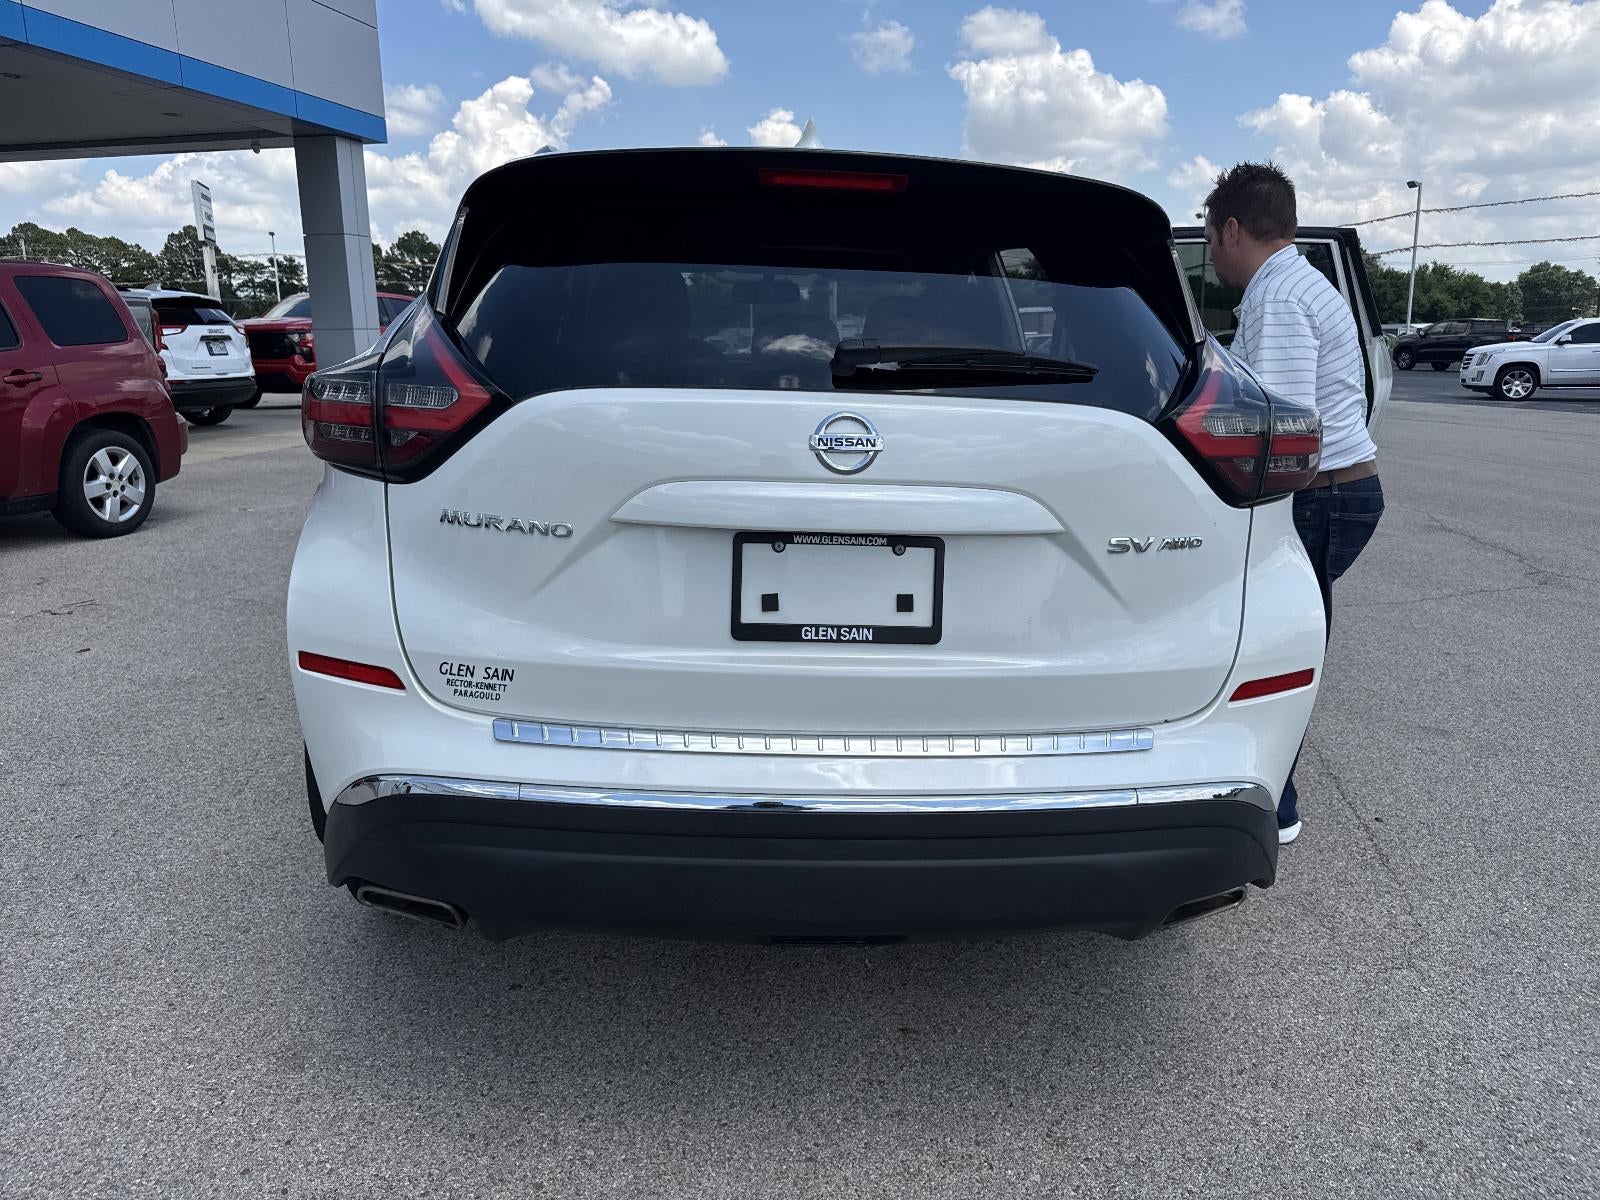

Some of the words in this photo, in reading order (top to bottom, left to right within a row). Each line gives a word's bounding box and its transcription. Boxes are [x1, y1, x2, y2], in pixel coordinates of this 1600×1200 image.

[817, 437, 877, 448] NISSAN
[439, 508, 574, 538] MURANO
[793, 534, 888, 546] WWW.GLENSAIN.COM
[1107, 536, 1156, 553] SV
[1157, 536, 1203, 552] AWD
[801, 626, 838, 640] GLEN
[840, 627, 873, 641] SAIN
[439, 661, 476, 678] GLEN
[482, 666, 515, 682] SAIN
[446, 678, 508, 692] RECTOR-KENNETT
[453, 688, 501, 701] PARAGOULD
